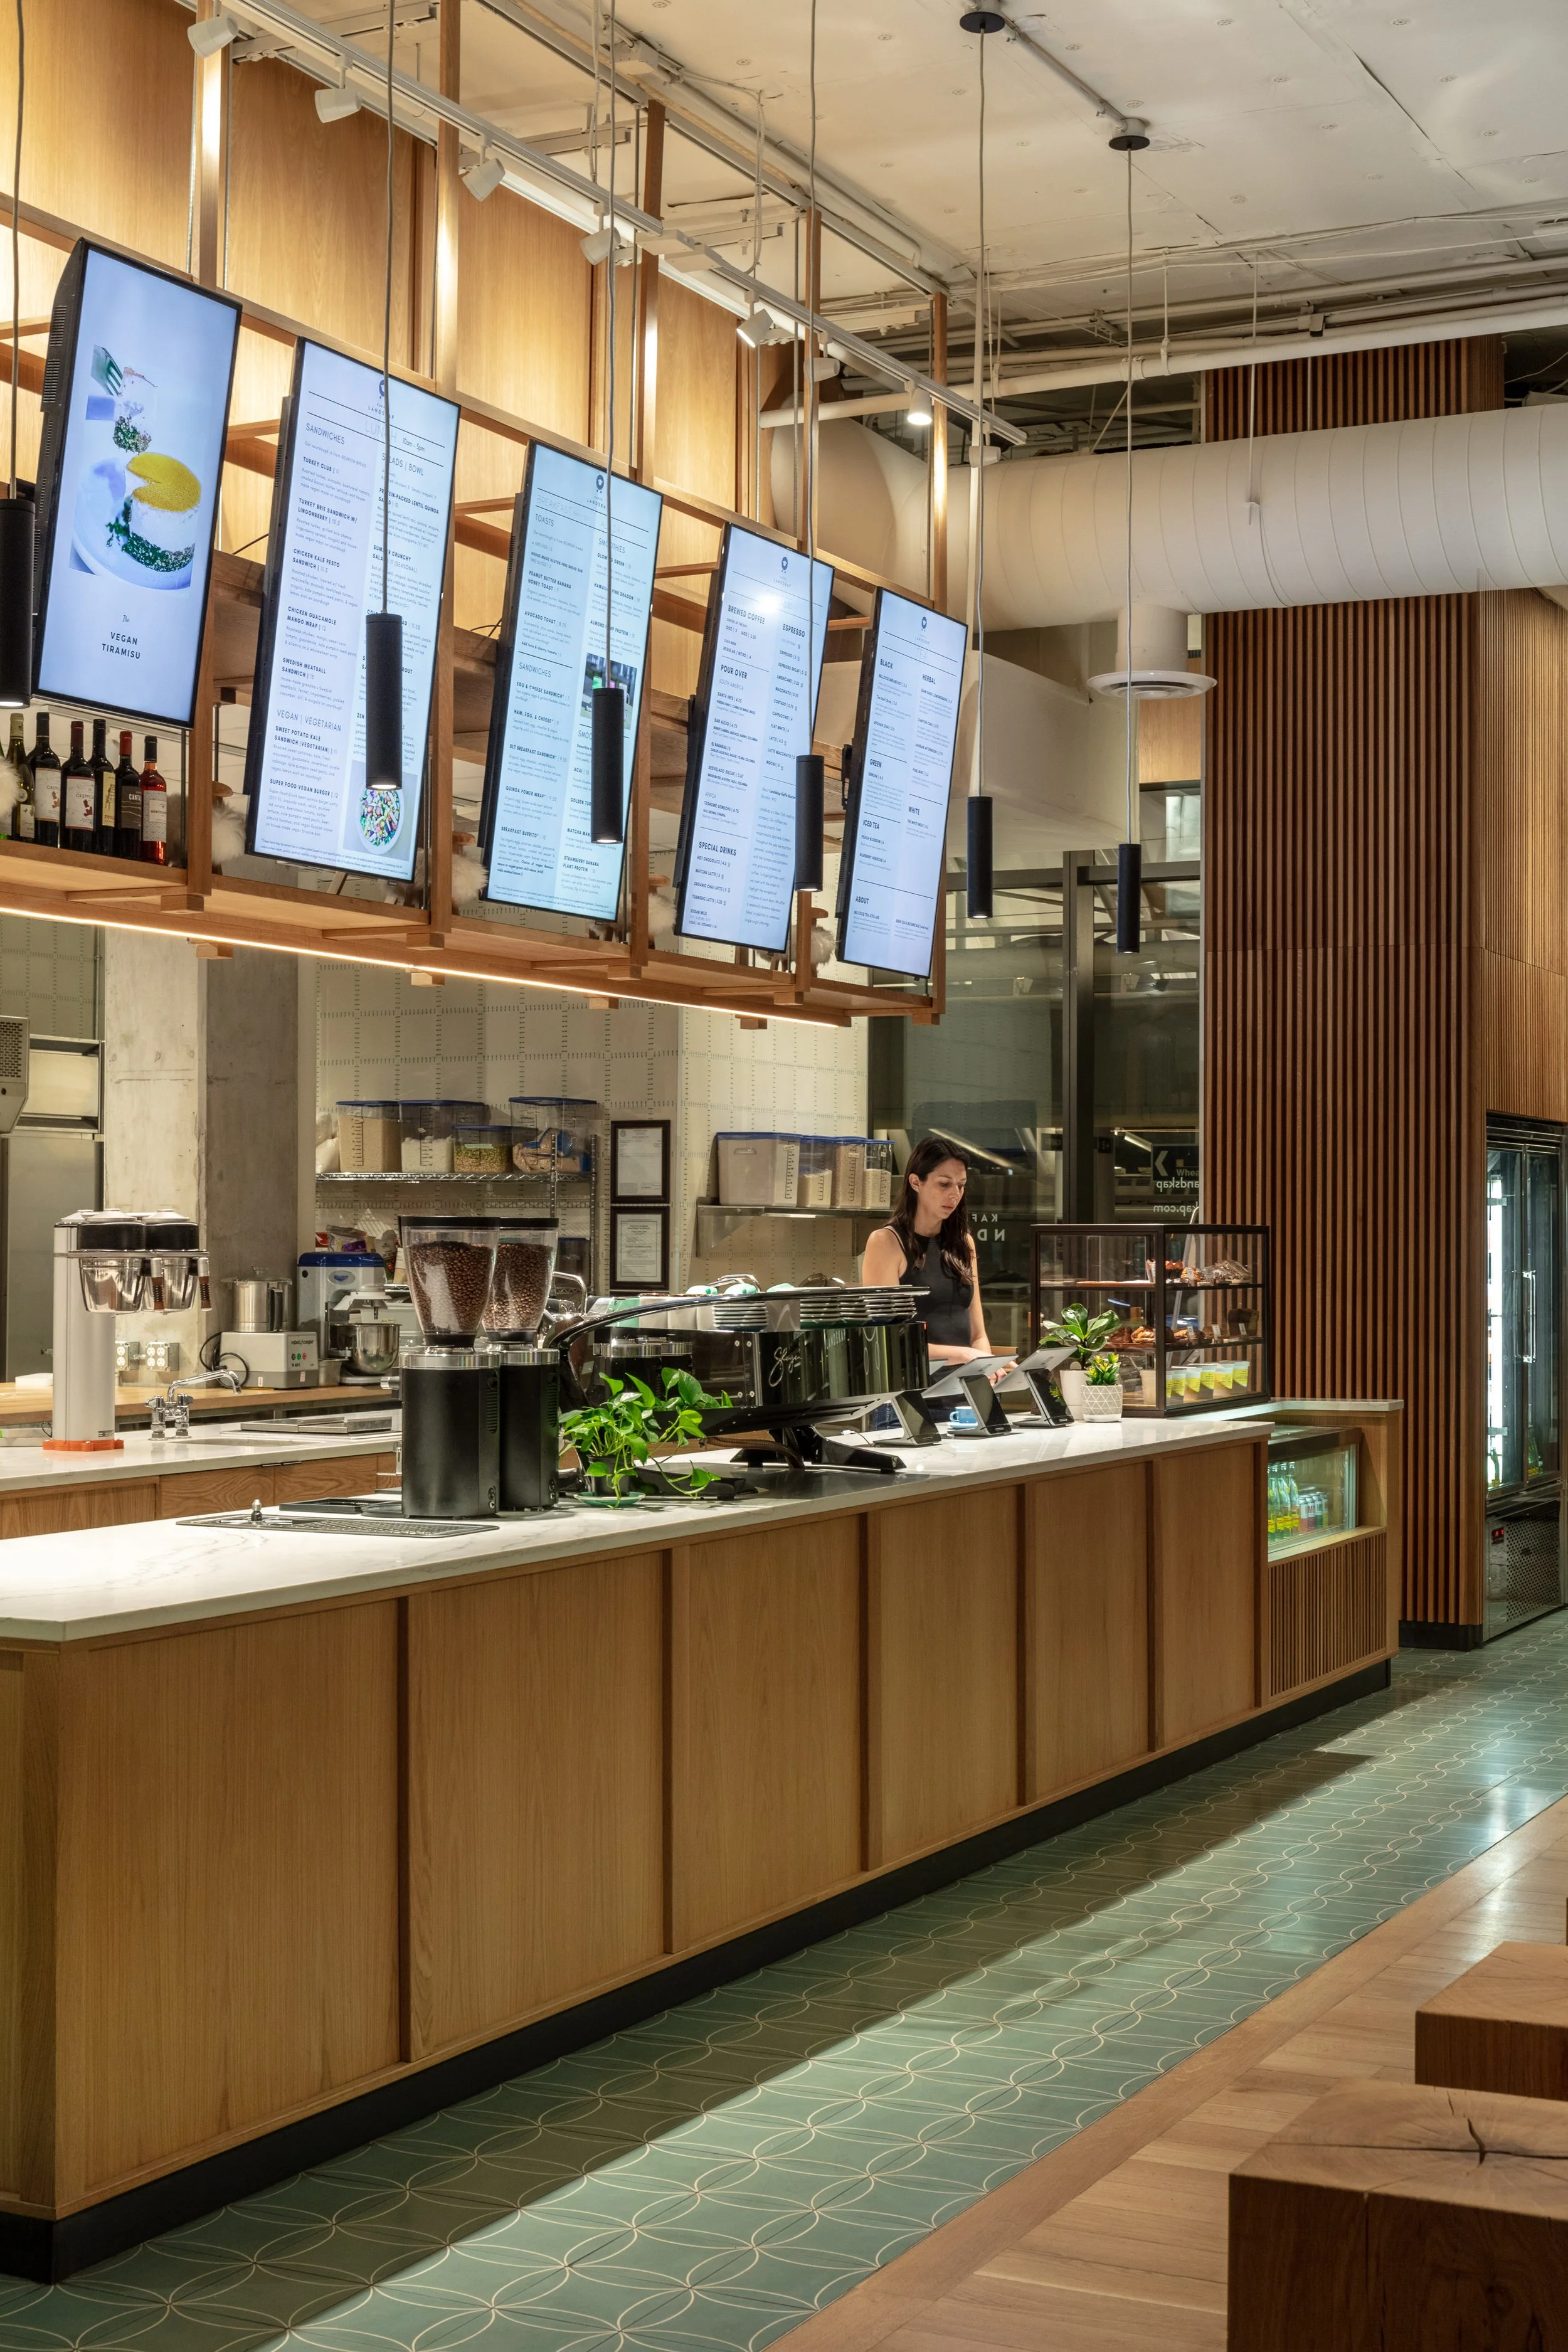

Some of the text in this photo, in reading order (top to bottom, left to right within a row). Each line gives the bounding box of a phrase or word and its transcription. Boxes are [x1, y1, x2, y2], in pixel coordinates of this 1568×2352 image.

[305, 422, 345, 445] SANDWICHES
[364, 419, 397, 443] LUNH
[415, 442, 425, 453] 3pm
[302, 456, 332, 472] TURKEY CLUB
[381, 452, 423, 477] SLADS BOWL
[378, 487, 439, 515] PRTEIN-PACKED LENTIL QUINOA
[297, 506, 328, 522] LINGONBERRY
[298, 497, 358, 524] TURKEY BRIE SANDWICH W/
[534, 513, 554, 527] TOASTS
[292, 556, 317, 570] SANDWICH
[293, 547, 340, 568] CHICKEN KALE PESTO
[391, 550, 411, 563] CRUNCHY
[613, 558, 625, 568] GREEN
[527, 578, 553, 591] HONEY TOAST
[528, 569, 571, 590] PEANUT BUTTER BANANA
[619, 591, 634, 601] DRAGON
[122, 614, 130, 623] The
[286, 614, 304, 625] MANGO
[304, 619, 317, 629] WRAP
[287, 605, 336, 625] CHICKEN GUACAMOLE
[524, 610, 556, 625] AVOCADO TOAST
[727, 604, 765, 625] BREWED COFFEE
[590, 618, 628, 637] ALMOND PROTEIN
[782, 623, 805, 638] ESPRESSO
[109, 632, 138, 645] VEGAN
[101, 643, 140, 659] TIRAMISU
[282, 657, 326, 674] SWEDISH MEATBALL
[518, 661, 551, 679] SANDWICHES
[879, 658, 893, 669] BLACK
[281, 665, 306, 678] SANDWICH
[720, 664, 748, 680] POUR OVER
[921, 674, 936, 685] HERBAL
[516, 681, 525, 689] EGG
[528, 684, 543, 694] CHEESE
[276, 708, 342, 733] VEGAN VEGETARIAN
[275, 724, 321, 742] SWEET POTATO KALE
[273, 734, 330, 754] SANDWICH (VEGETARIAN)
[516, 745, 536, 756] BREAKFAST
[869, 758, 882, 768] GREEN
[269, 778, 284, 787] SUPER
[283, 781, 297, 790] FOOD
[297, 783, 313, 793] VEGAN
[313, 787, 331, 797] BURGER
[505, 785, 520, 794] QUINOA
[520, 788, 533, 797] POWER
[908, 805, 920, 815] WHITE
[501, 825, 521, 835] BREAKFAST
[862, 818, 880, 830] ICED TEA
[697, 840, 736, 856] SPECIAL DRINKS
[563, 855, 599, 867] STRAWBERRY BANANA
[855, 895, 869, 905] ABOUT
